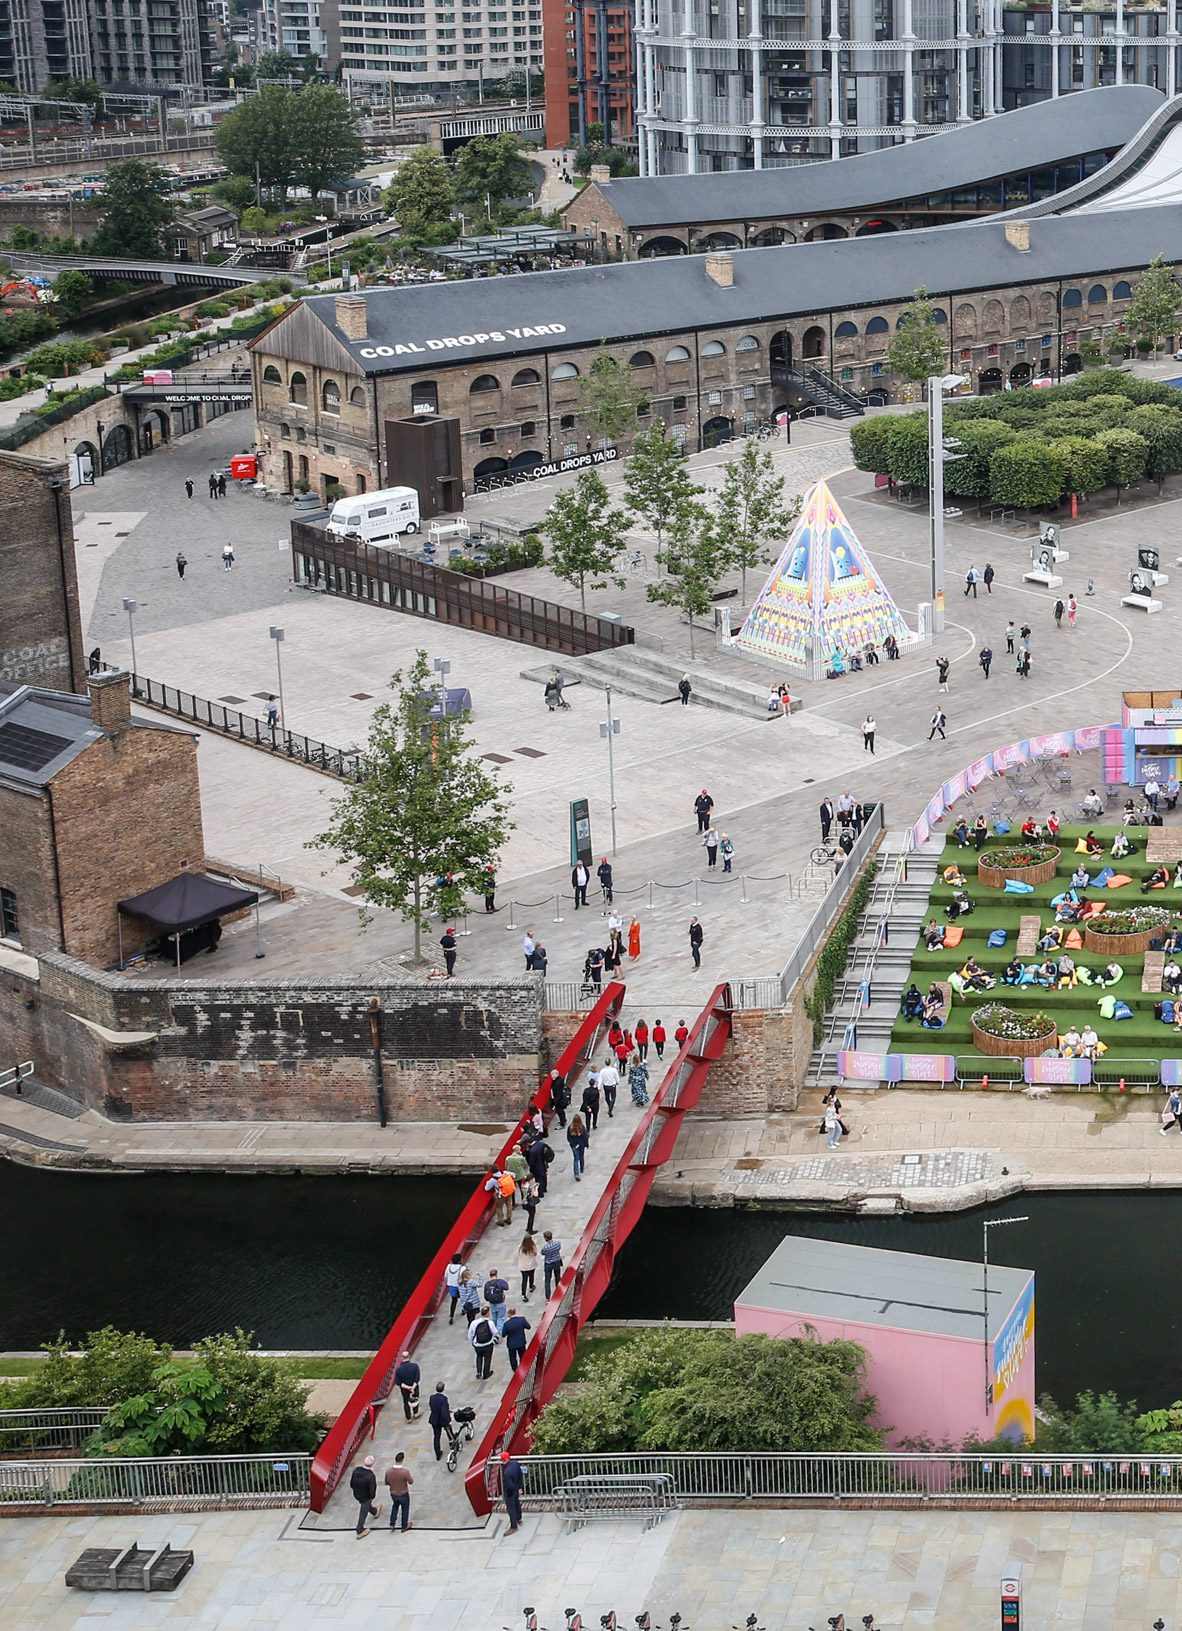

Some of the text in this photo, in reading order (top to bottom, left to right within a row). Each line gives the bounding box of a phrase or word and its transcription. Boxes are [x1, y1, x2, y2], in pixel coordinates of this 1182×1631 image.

[359, 323, 567, 359] COAL DROPS YARD
[533, 449, 616, 478] COAL DROPS YARD
